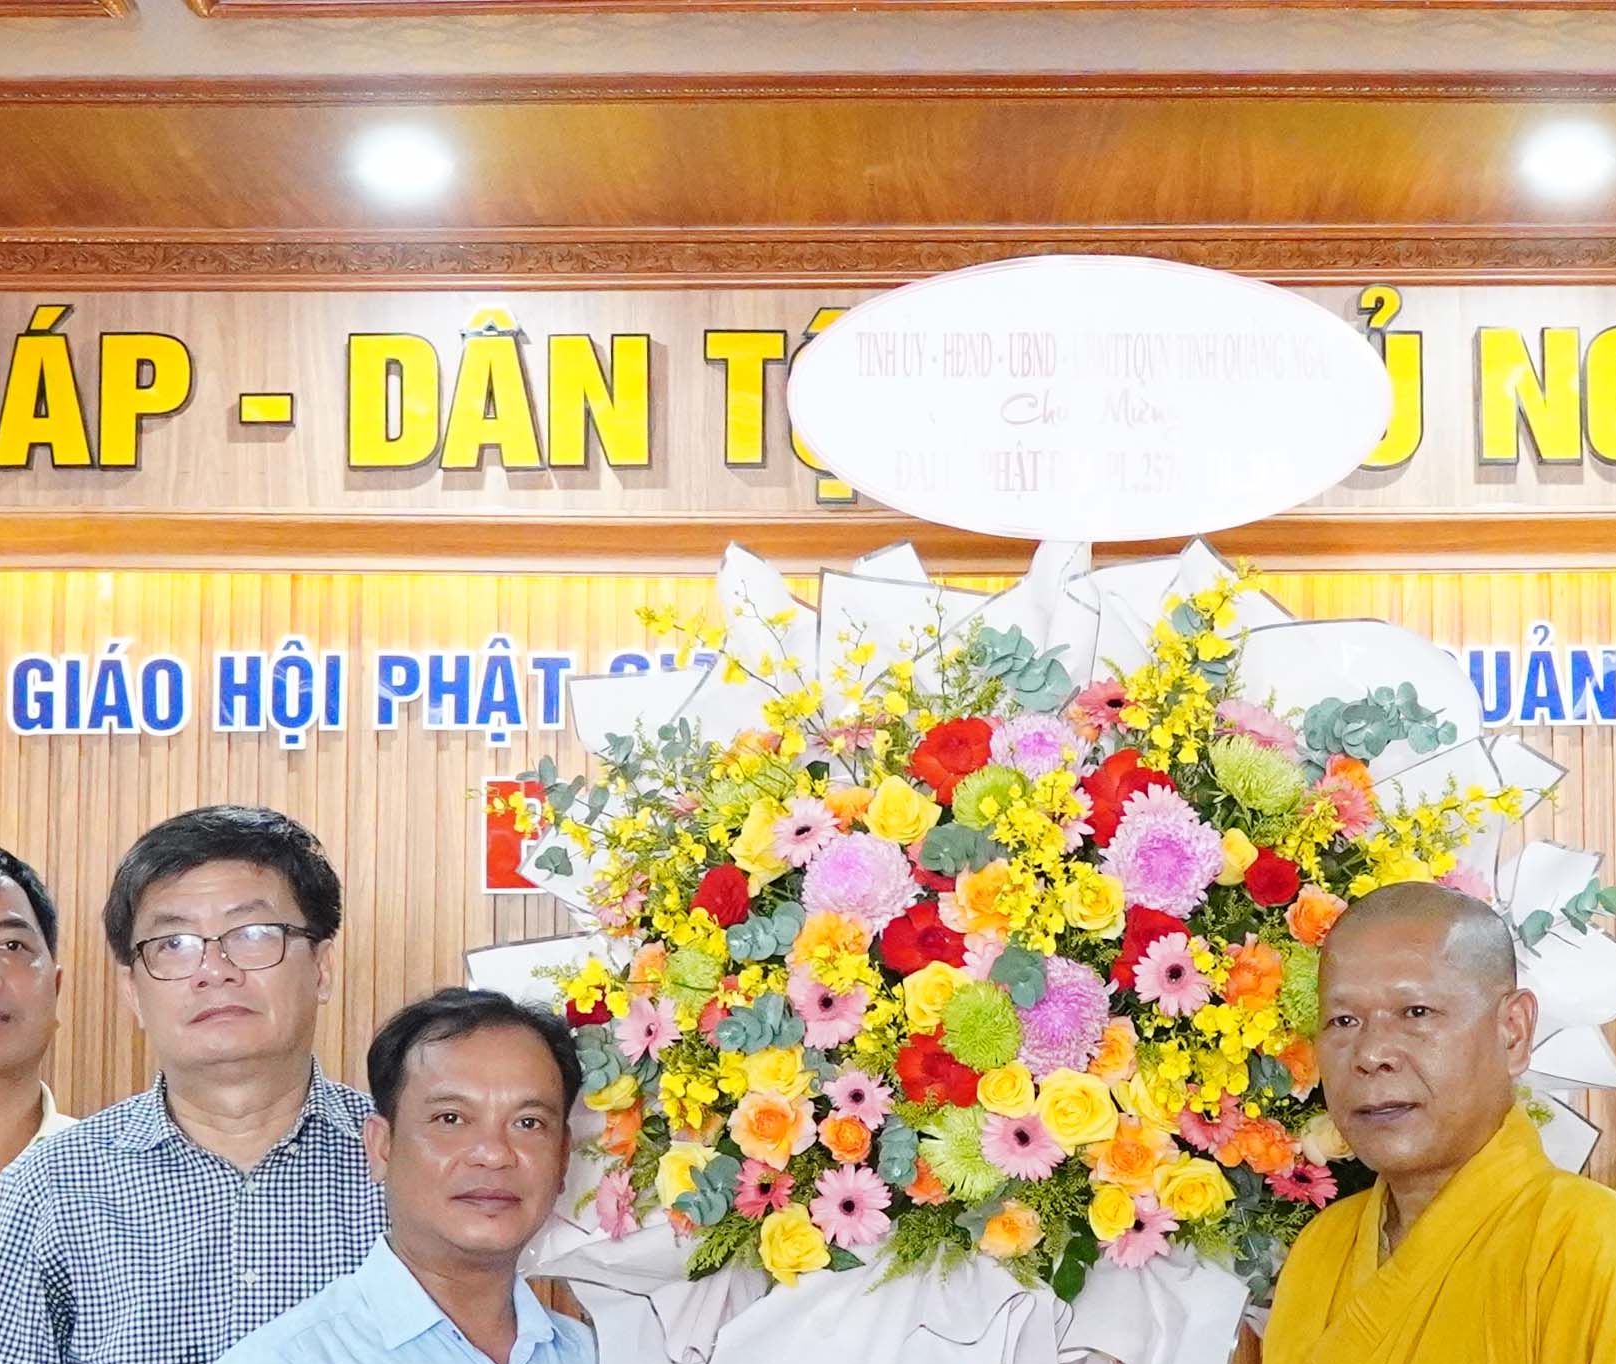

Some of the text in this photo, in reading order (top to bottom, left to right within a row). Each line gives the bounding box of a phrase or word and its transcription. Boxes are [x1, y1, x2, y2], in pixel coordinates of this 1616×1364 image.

[239, 392, 295, 426] -
[347, 306, 651, 471] DÂN
[943, 331, 993, 378] HĐND
[1008, 331, 1058, 378] UBND
[11, 641, 185, 731] GIÁO
[219, 640, 342, 745] HỘI
[379, 637, 571, 745] PHẬT
